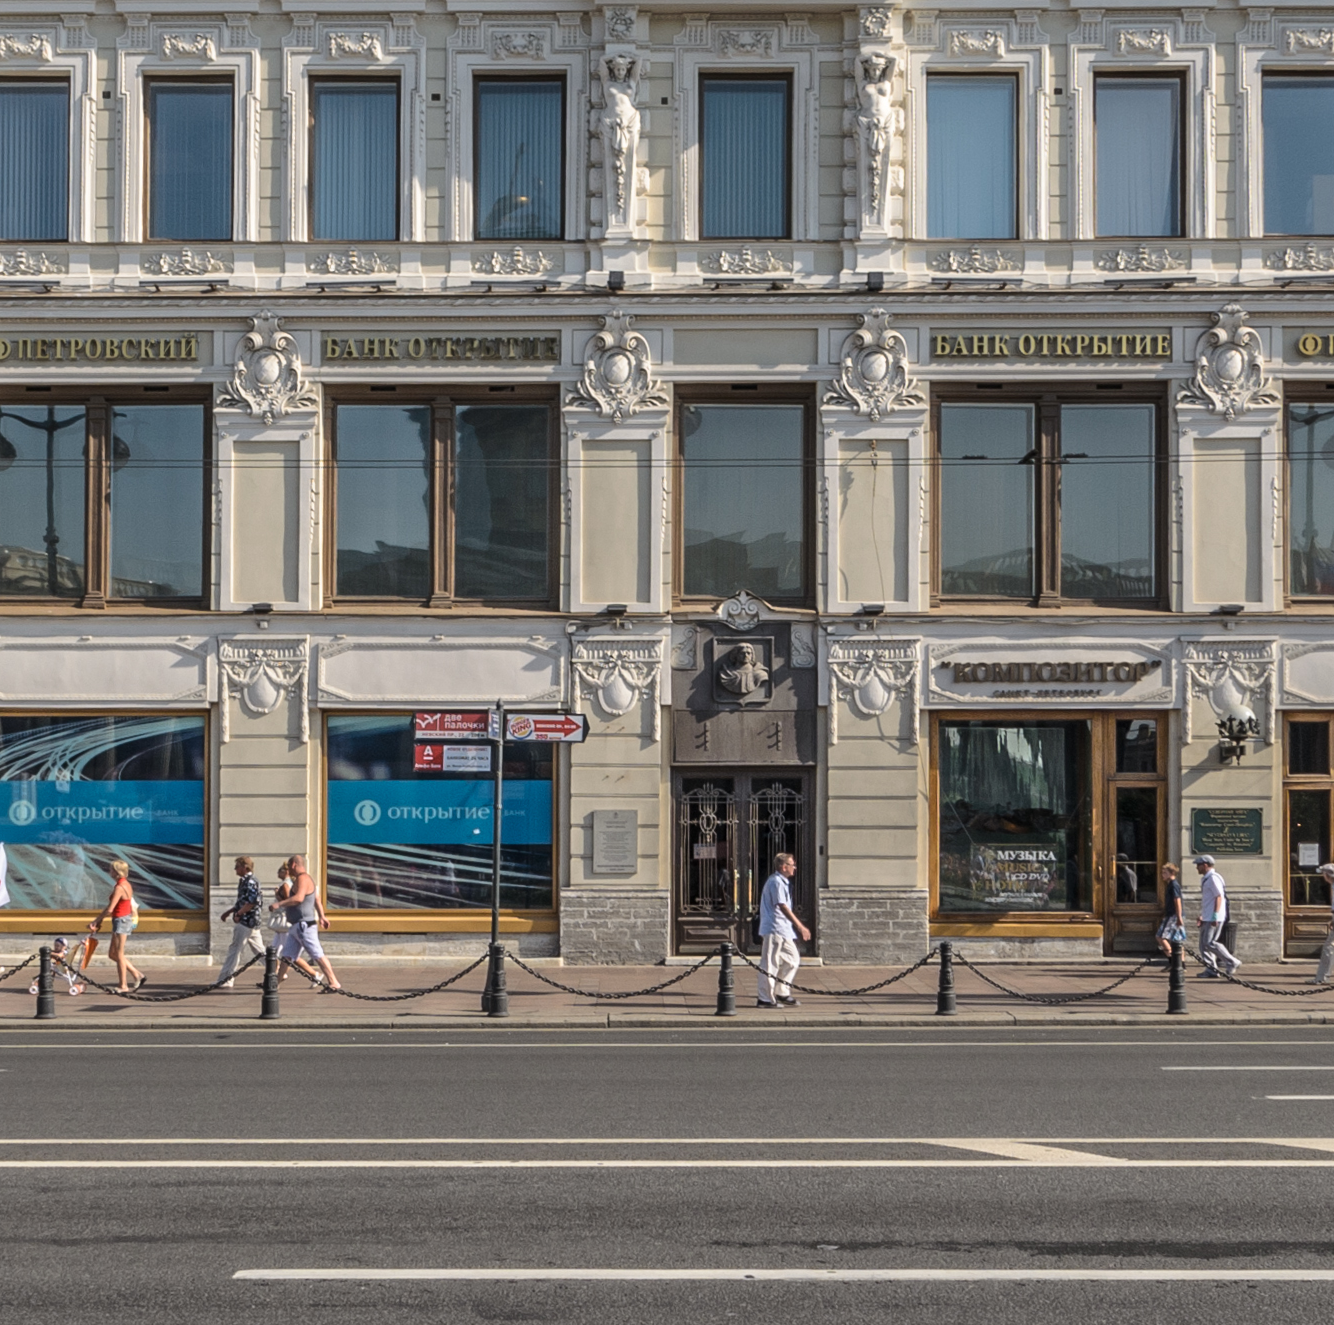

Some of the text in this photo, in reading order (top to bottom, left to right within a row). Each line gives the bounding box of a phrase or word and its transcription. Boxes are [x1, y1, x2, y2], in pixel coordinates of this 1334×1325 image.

[17, 332, 199, 361] ПЕТРОВСКИЙ
[325, 336, 559, 361] БАНК ОТКРЫТИЕ
[934, 334, 1171, 357] БАНК ОТКРЫТИЕ
[42, 806, 144, 823] открытие
[388, 806, 526, 823] открытие БАНК
[997, 850, 1056, 861] МУЗЫКА
[997, 862, 1042, 873] MUSIC
[1011, 873, 1050, 881] CD DVD
